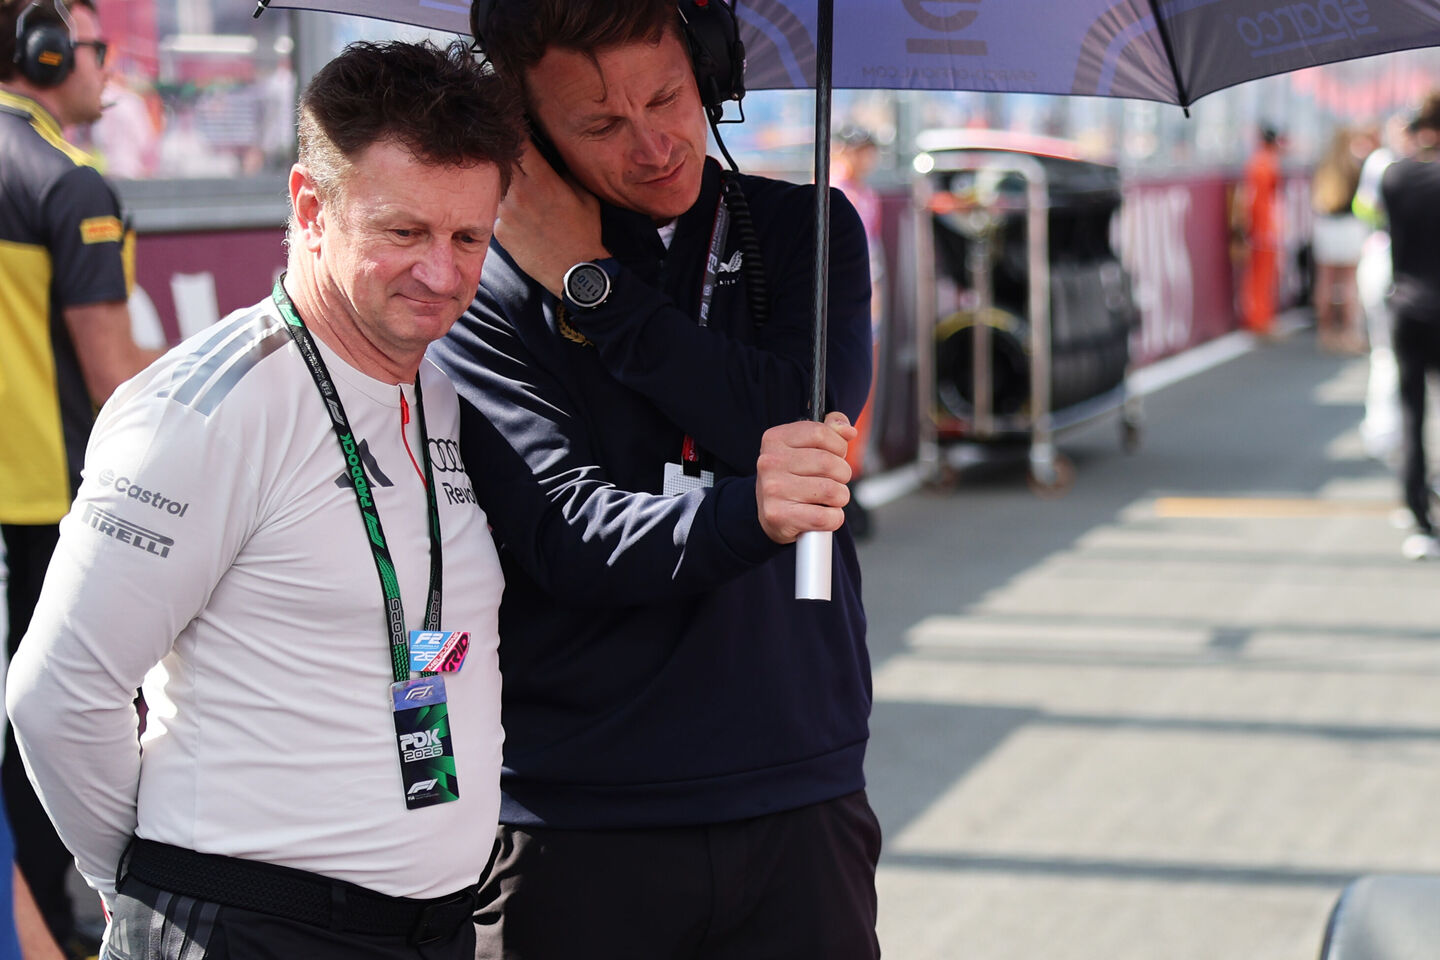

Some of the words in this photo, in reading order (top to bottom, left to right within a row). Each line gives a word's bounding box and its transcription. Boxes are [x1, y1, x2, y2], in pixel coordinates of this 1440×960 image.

[707, 252, 718, 274] F3
[700, 302, 709, 320] F3
[340, 432, 373, 508] PADDOCK
[115, 477, 189, 517] Castrol
[81, 502, 175, 559] PIRELLI
[389, 597, 406, 646] 2026
[415, 632, 444, 645] F2
[399, 728, 443, 752] PDK
[403, 744, 444, 763] 2026
